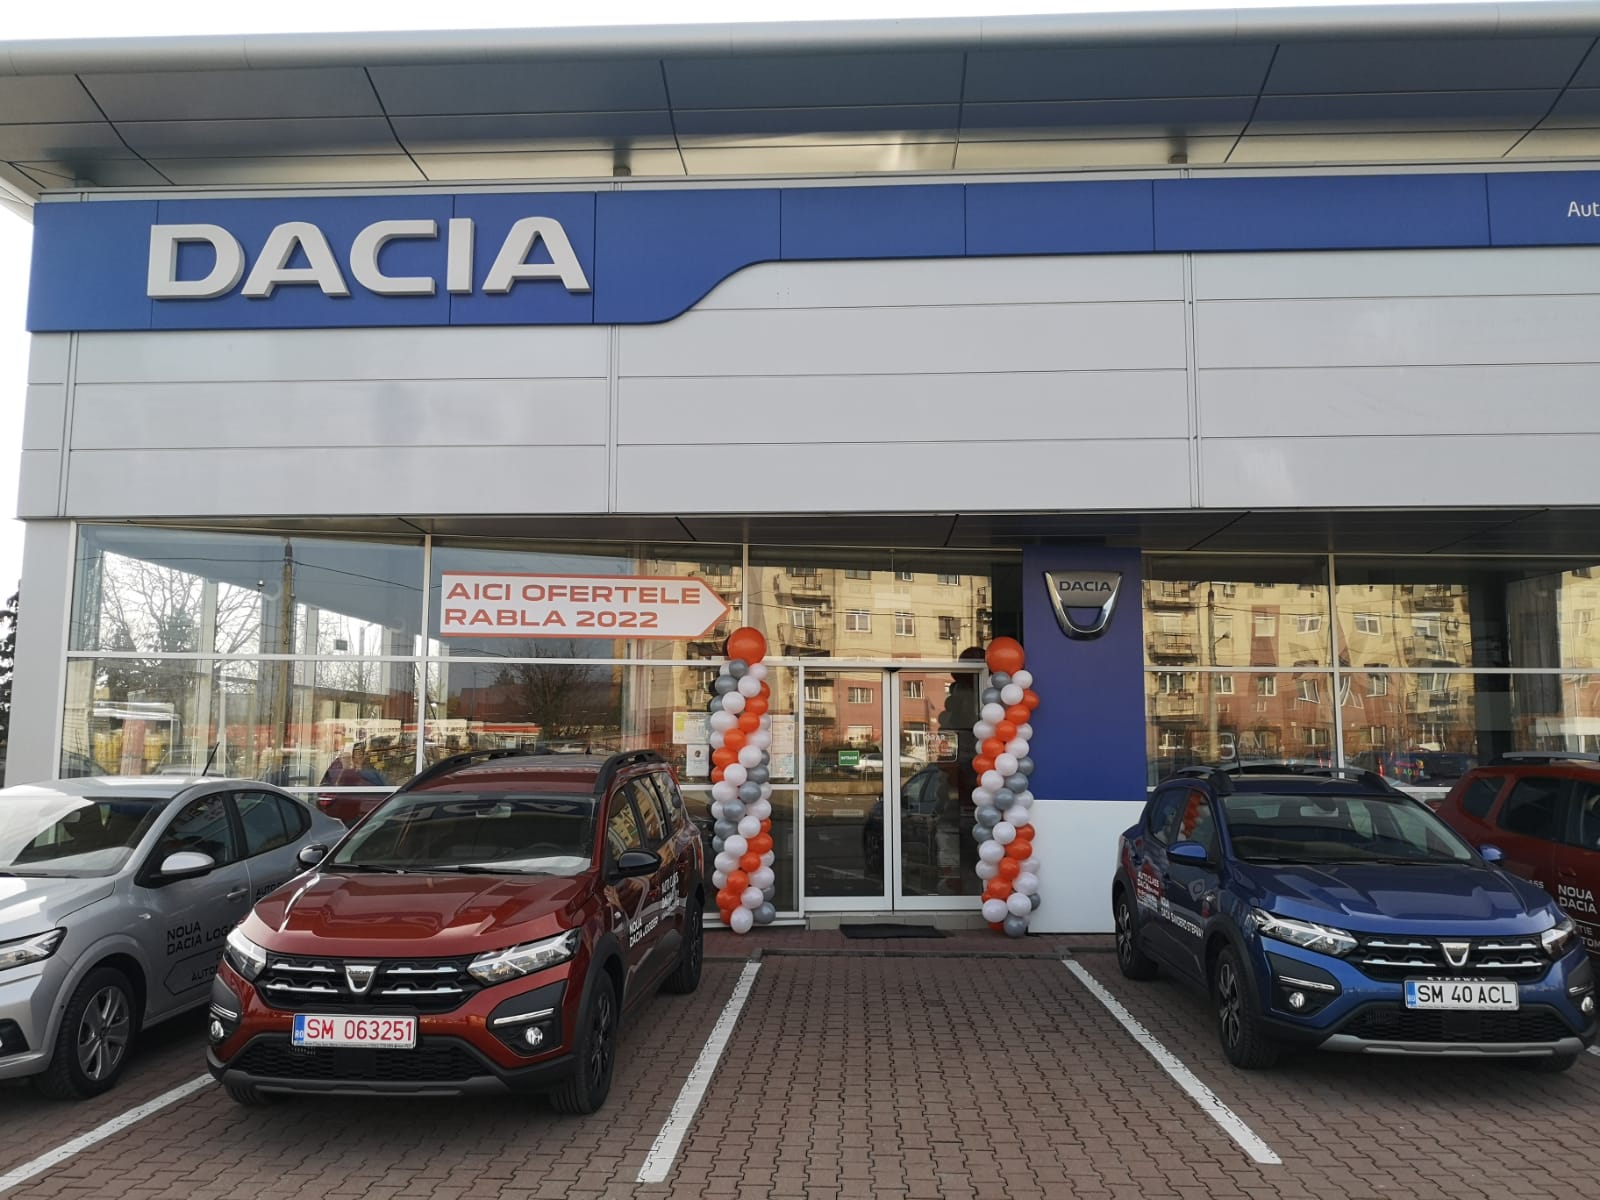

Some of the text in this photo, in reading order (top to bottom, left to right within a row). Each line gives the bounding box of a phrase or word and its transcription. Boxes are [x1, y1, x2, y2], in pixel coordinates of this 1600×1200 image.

[147, 216, 592, 299] DACIA
[446, 582, 700, 604] AICI OFERTELE
[1059, 580, 1112, 592] DACIA
[444, 608, 658, 628] RABLA 2022
[1558, 884, 1594, 902] NOUA
[1559, 896, 1598, 914] DACIA
[167, 921, 201, 942] NOUA
[167, 933, 202, 956] DACIA
[192, 965, 218, 981] AUTO
[1417, 985, 1443, 1003] SM
[1451, 985, 1473, 1003] 40
[1478, 986, 1512, 1004] ACL
[307, 1018, 334, 1040] SM
[344, 1020, 413, 1041] 063251
